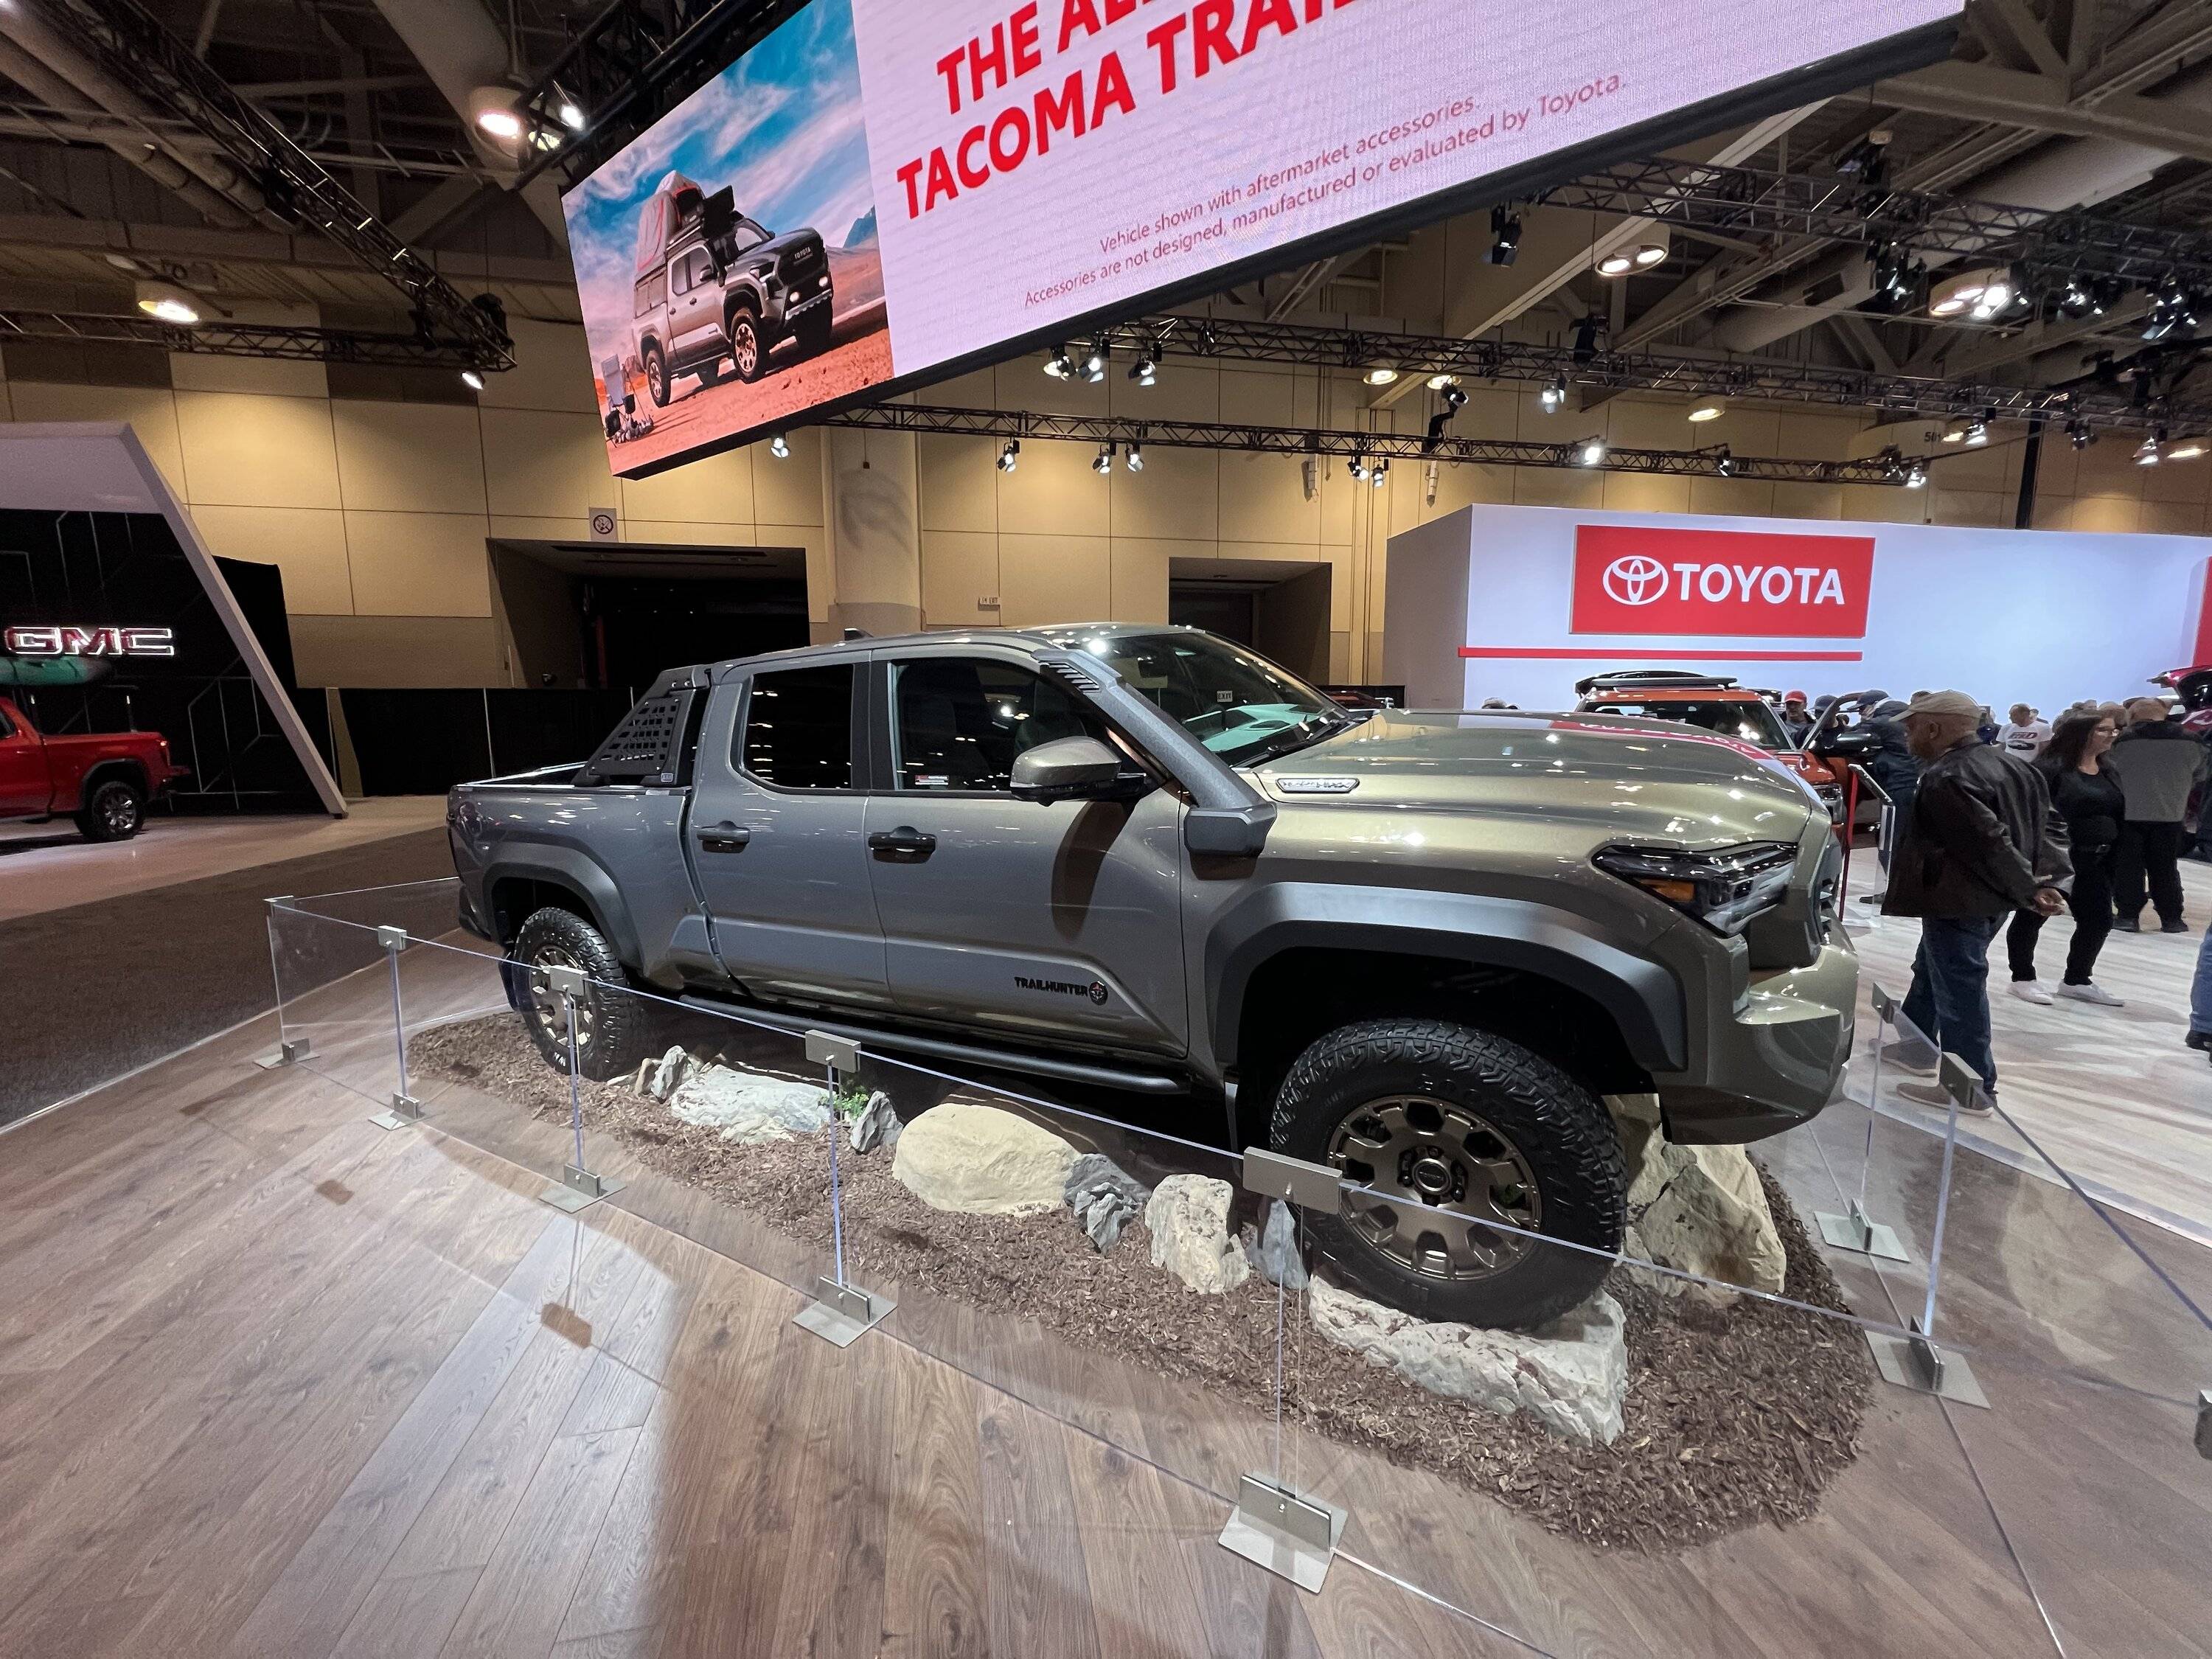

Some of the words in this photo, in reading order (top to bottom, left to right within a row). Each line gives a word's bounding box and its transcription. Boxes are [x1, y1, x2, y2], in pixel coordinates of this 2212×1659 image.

[936, 1, 1042, 115] THE
[897, 52, 1136, 220] TACOMA
[1023, 271, 1097, 307] Accessories
[1100, 260, 1121, 279] are
[1125, 249, 1150, 270] not
[1152, 217, 1228, 260] designed,
[1232, 167, 1357, 230] manufactured
[1363, 162, 1383, 181] or
[1389, 114, 1495, 173] evaluated
[1502, 108, 1531, 133] by
[1537, 72, 1627, 116] Toyota.
[1099, 223, 1150, 254] Vehicle
[1155, 204, 1203, 234] shown
[1207, 186, 1242, 213] with
[1246, 143, 1349, 198] aftermarket
[1355, 94, 1481, 155] accessories.
[1672, 562, 1846, 605] TOYOTA
[4, 627, 175, 655] GMC
[1014, 976, 1088, 997] TRAILHUNTER
